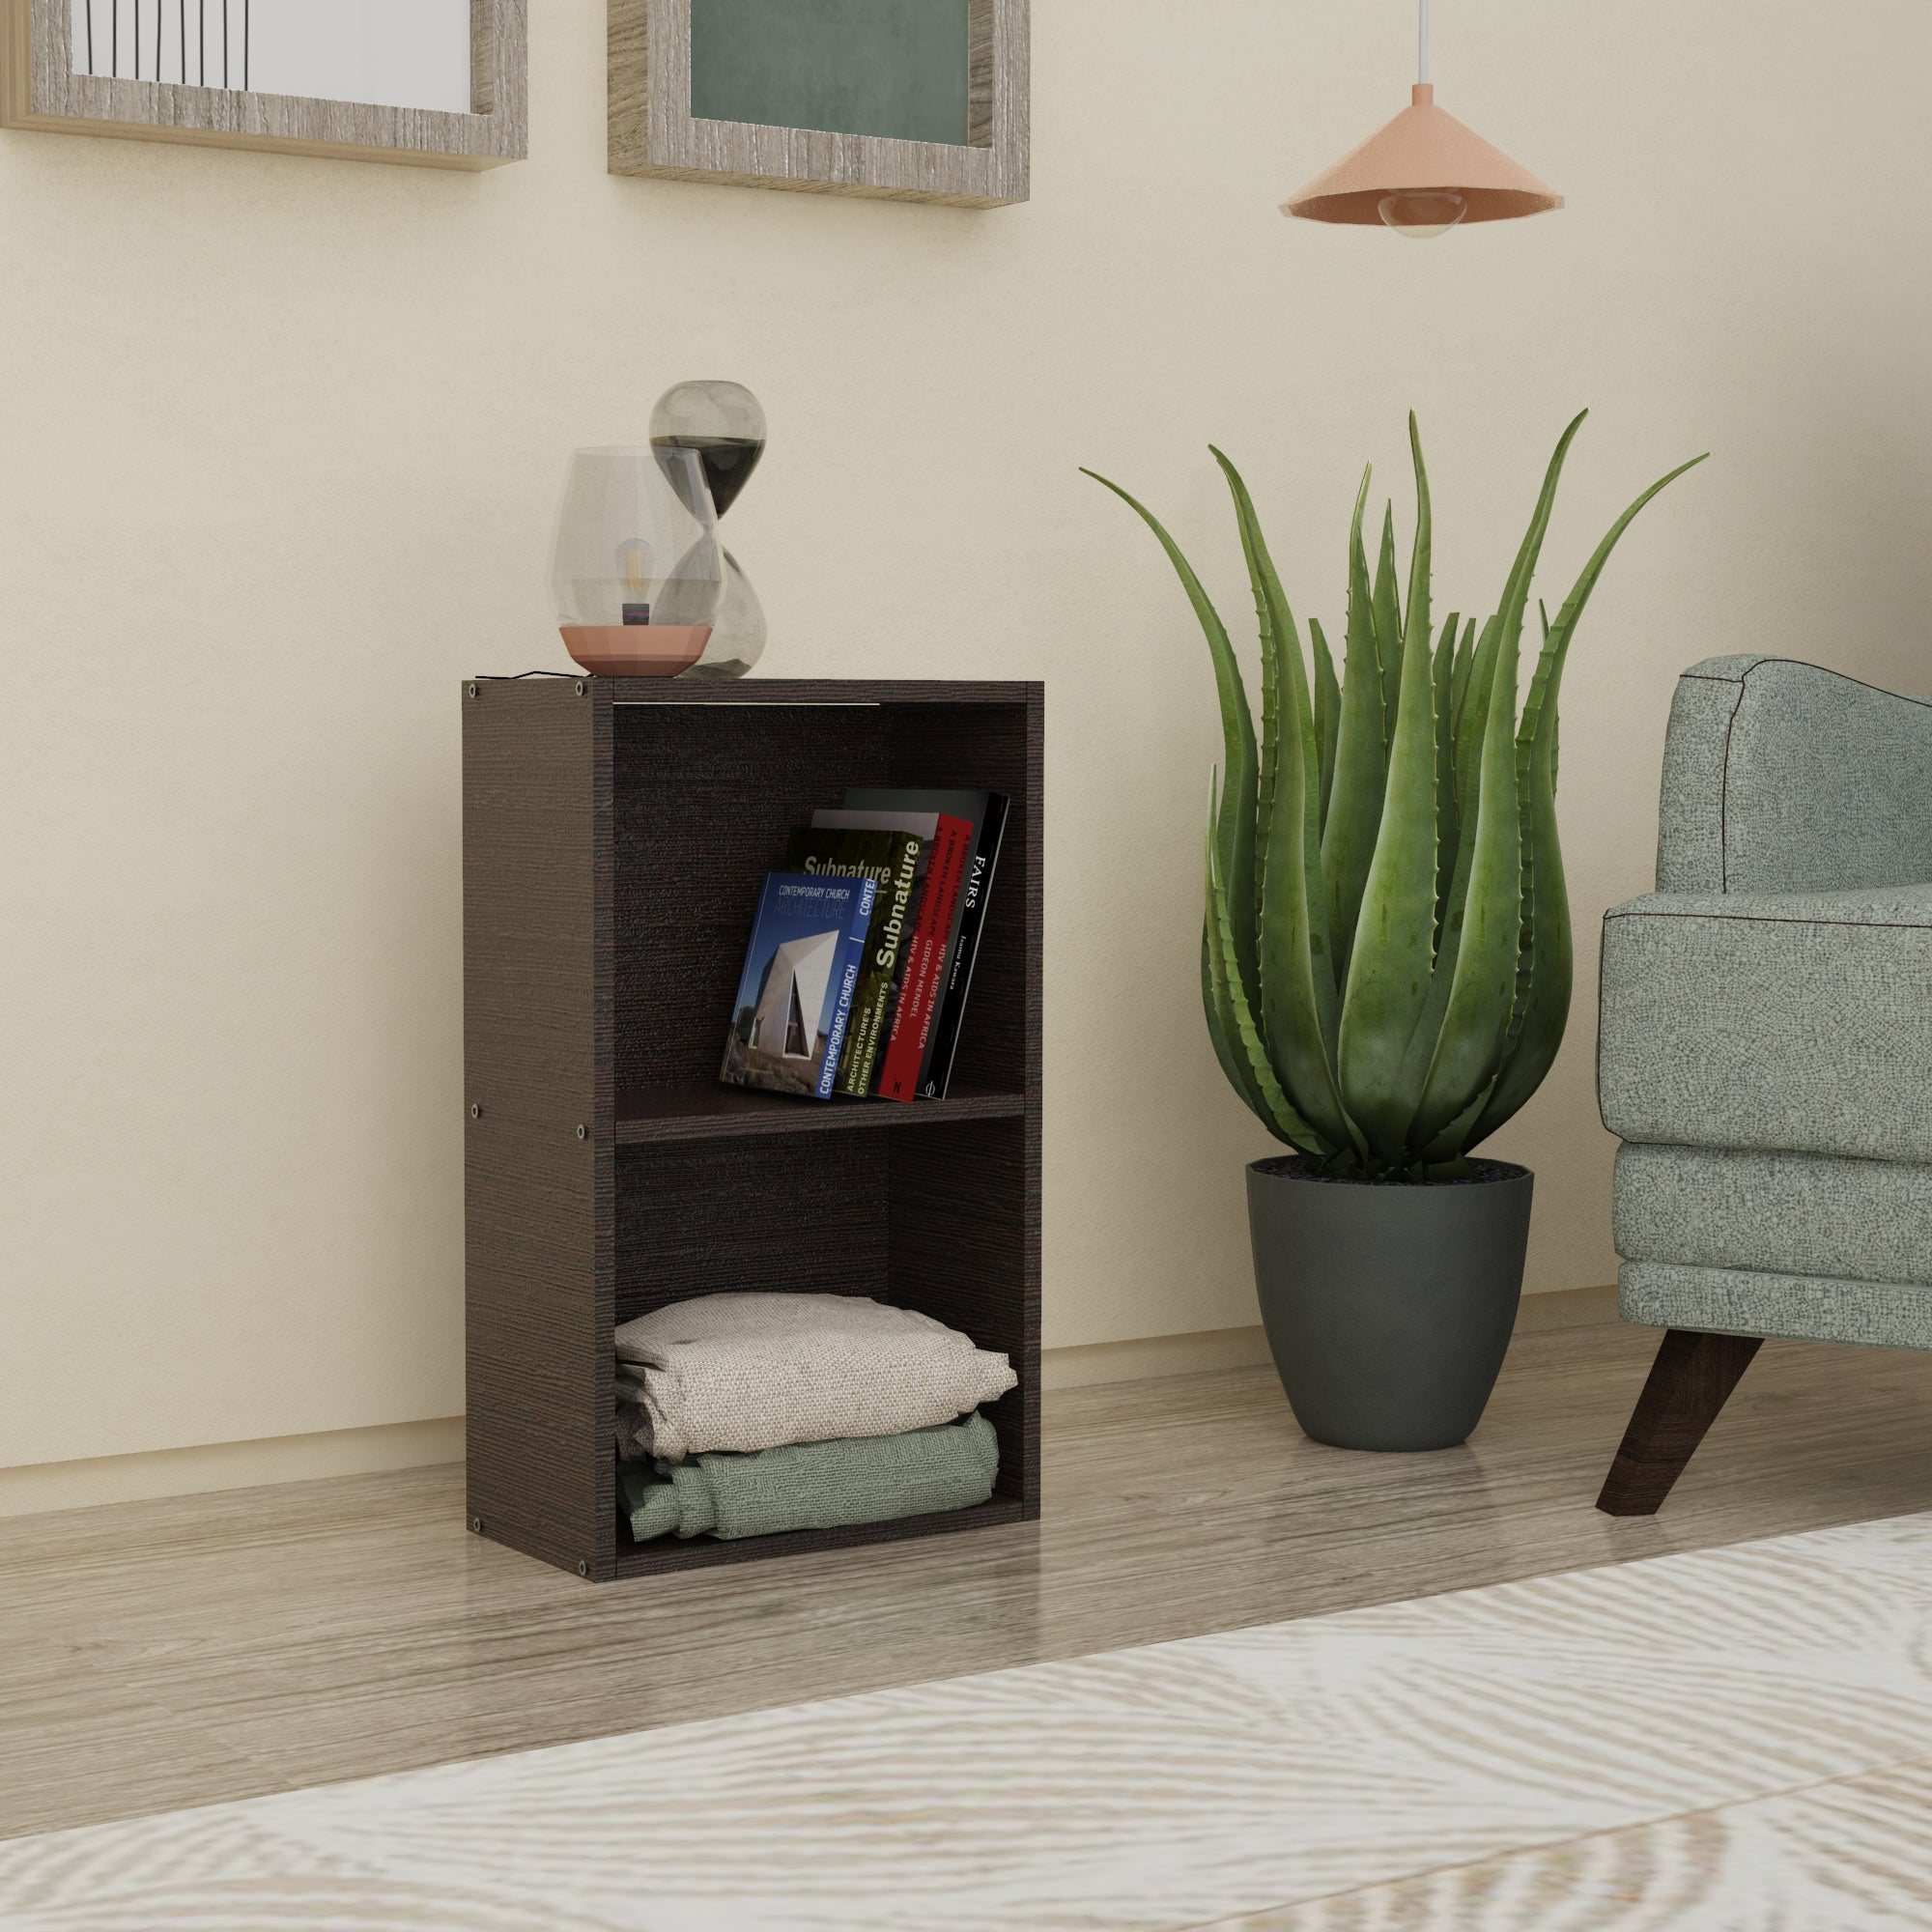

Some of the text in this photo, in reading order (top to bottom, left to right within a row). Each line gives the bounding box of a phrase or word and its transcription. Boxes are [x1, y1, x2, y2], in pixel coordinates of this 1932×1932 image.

[803, 855, 892, 884] Subnature
[942, 839, 955, 878] BROKEN
[779, 885, 851, 900] CONTEMPORARY CHURCH
[965, 855, 985, 910] FAIRS
[876, 840, 920, 969] Subnature
[928, 880, 946, 937] LANDSCAPE
[919, 939, 933, 977] GIDEON
[937, 944, 947, 961] HIV
[900, 966, 912, 990] AIDS
[928, 974, 941, 999] AIDS
[897, 991, 906, 1005] IN
[909, 978, 923, 1019] MENDEL
[925, 999, 935, 1013] IN
[819, 964, 857, 1094] CONTEMPORARY CHURCH
[857, 980, 889, 1095] OTHER ENVIRONMENTS
[890, 1006, 903, 1042] AFRICA
[918, 1014, 932, 1050] AFRICA
[846, 1007, 871, 1093] ARCHITECTURE'S
